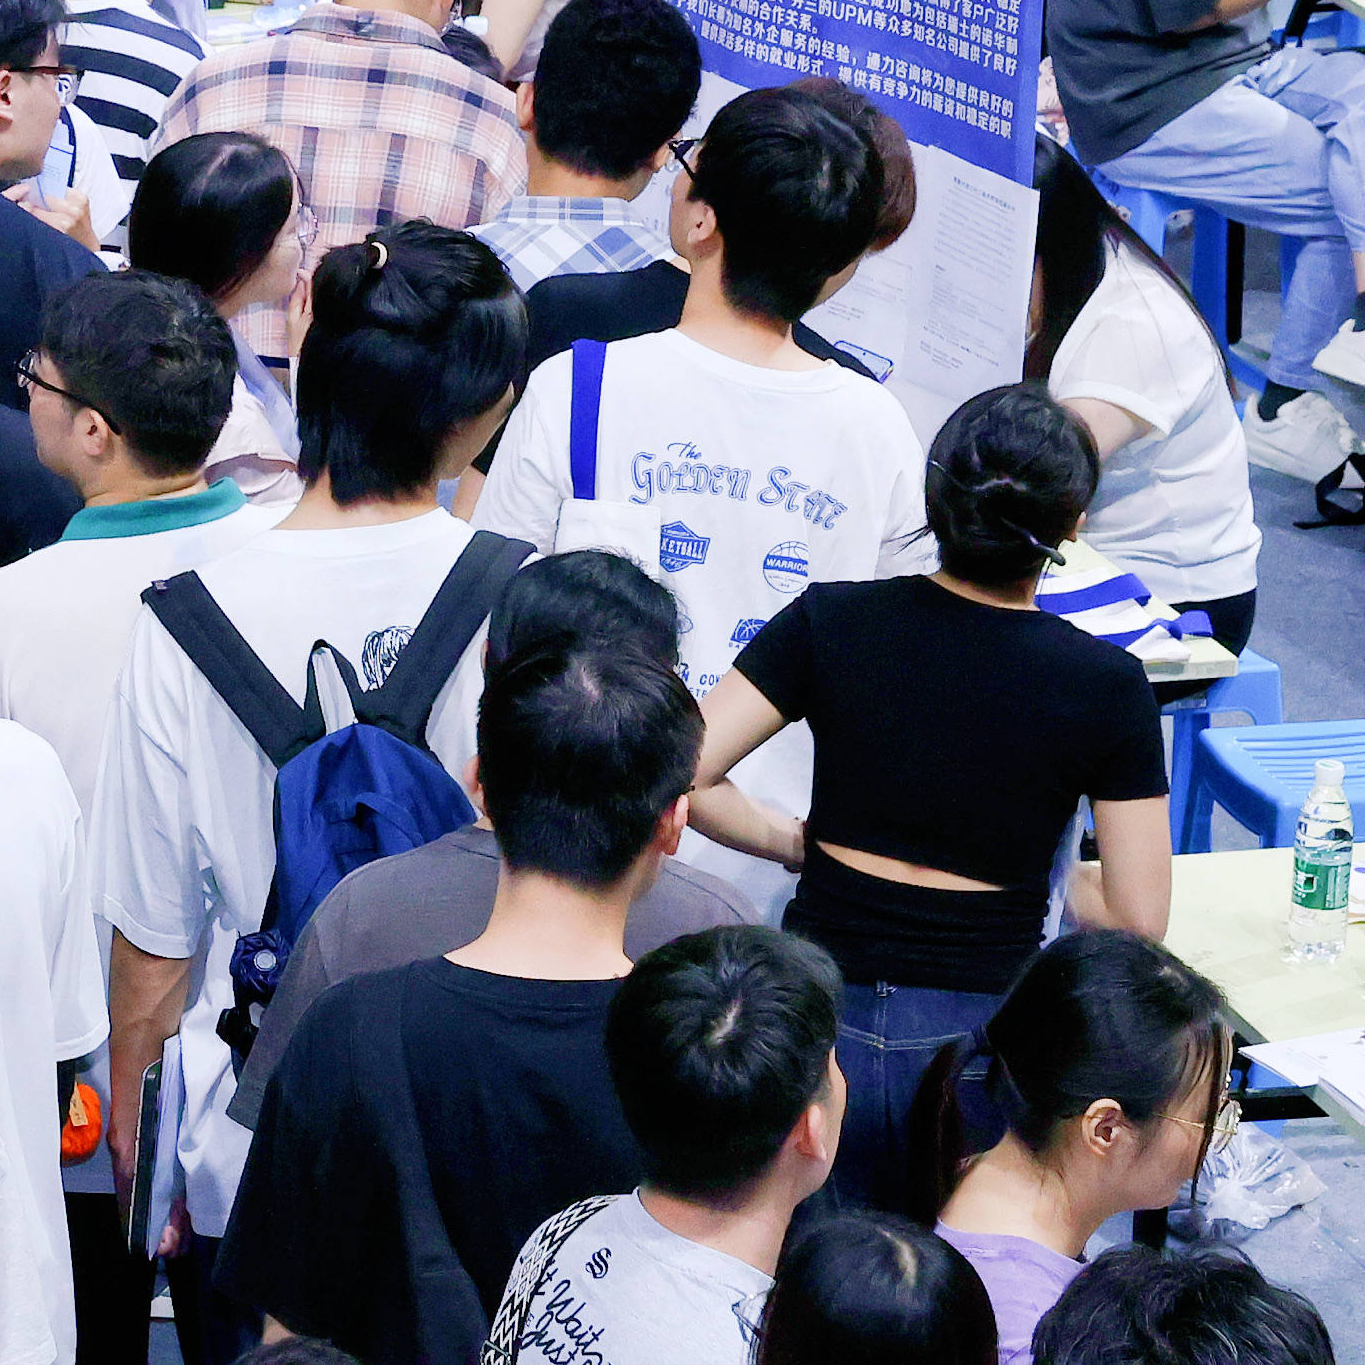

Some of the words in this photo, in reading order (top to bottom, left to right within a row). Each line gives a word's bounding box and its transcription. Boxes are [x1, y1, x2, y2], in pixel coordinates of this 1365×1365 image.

[667, 441, 702, 460] The
[628, 451, 752, 506] GOLDEN
[765, 555, 810, 576] WARRIOR
